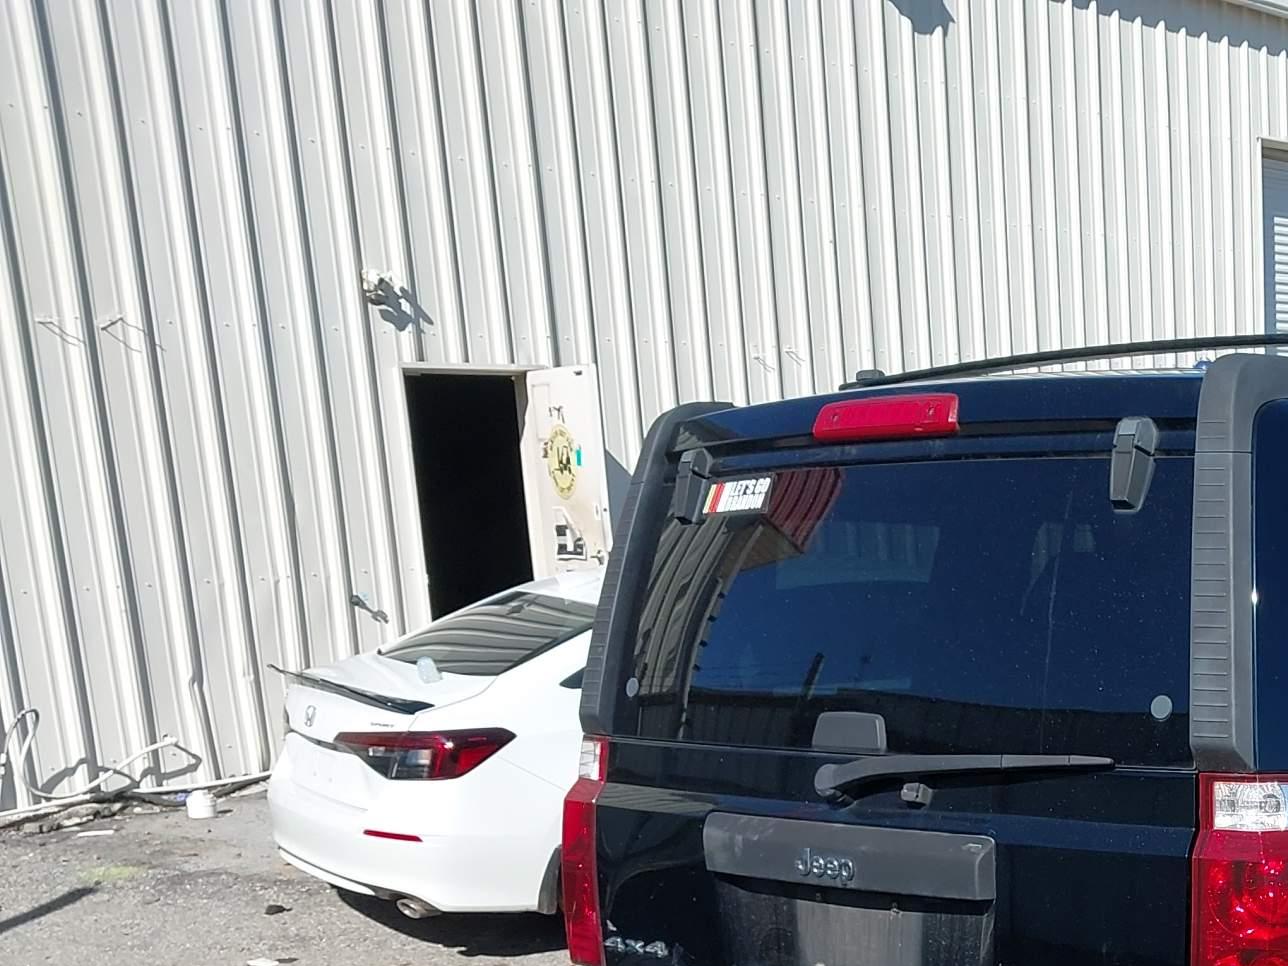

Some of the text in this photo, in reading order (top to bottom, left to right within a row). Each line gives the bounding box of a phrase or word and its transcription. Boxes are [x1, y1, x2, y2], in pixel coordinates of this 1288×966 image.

[729, 477, 771, 497] LET'S GO
[794, 847, 856, 886] Jeep
